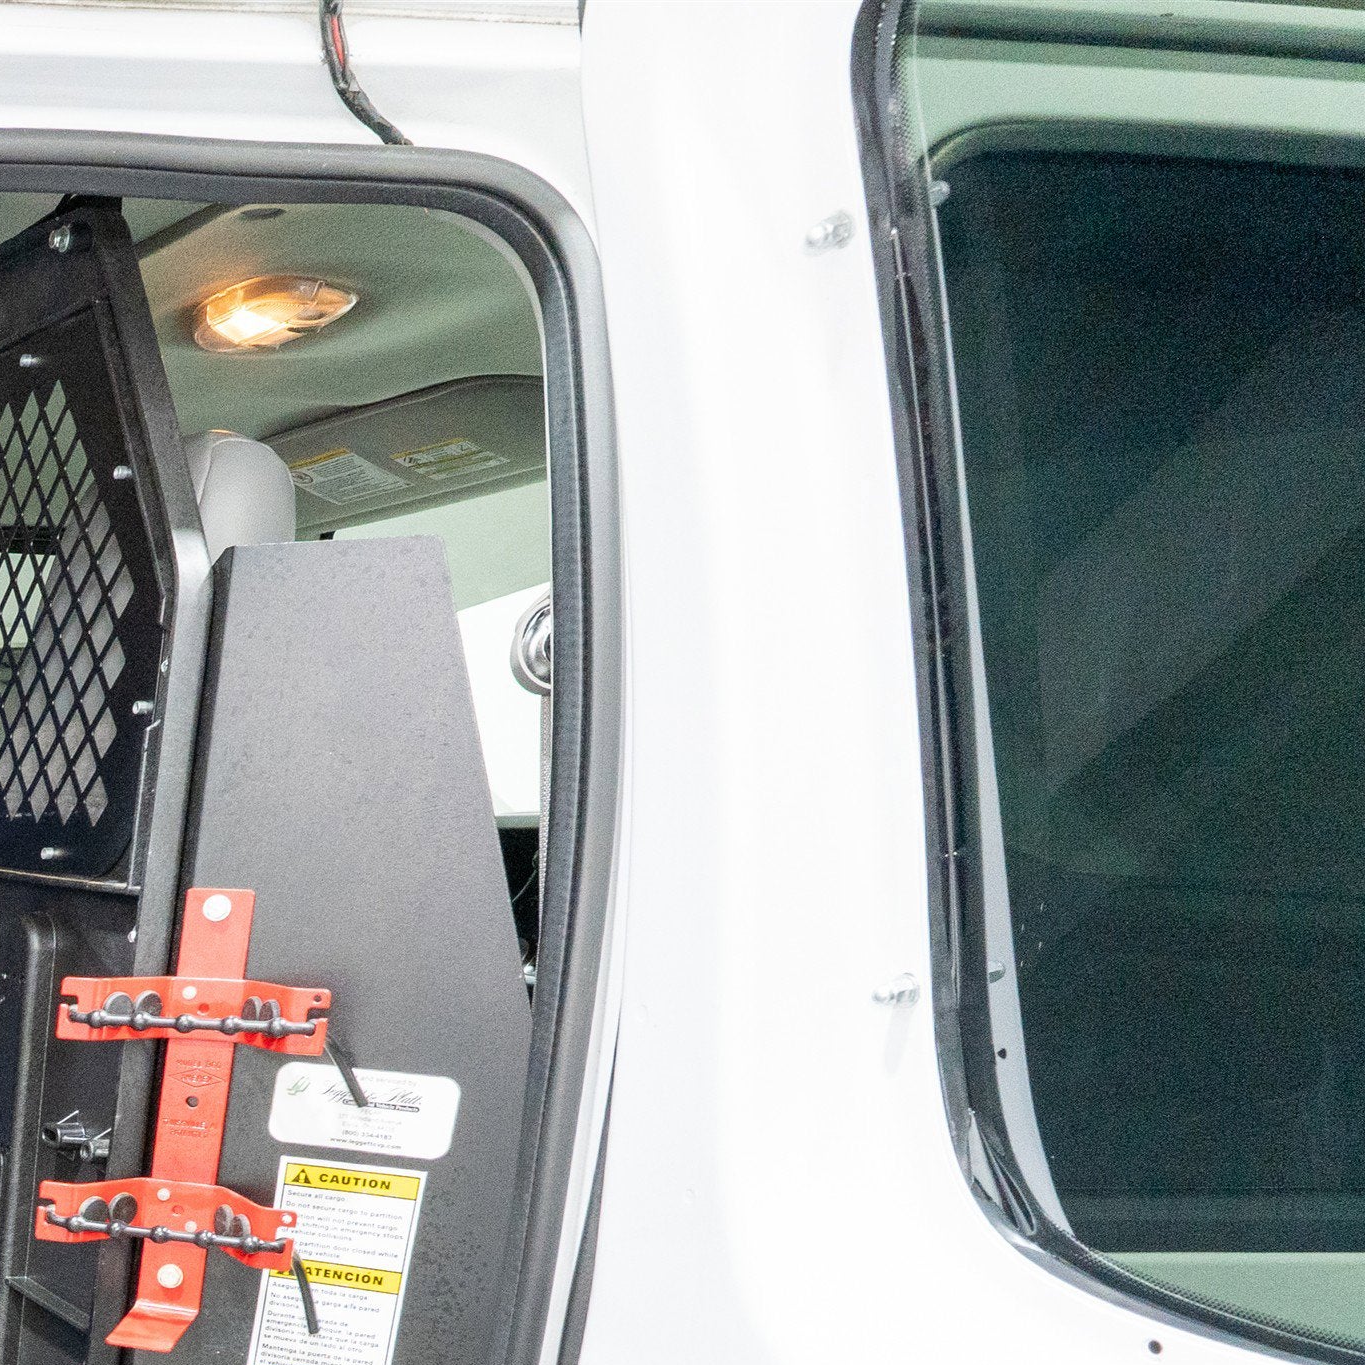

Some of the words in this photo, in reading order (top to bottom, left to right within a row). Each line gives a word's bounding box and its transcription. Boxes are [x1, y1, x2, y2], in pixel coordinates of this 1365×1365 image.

[319, 1174, 390, 1190] CAUTION
[370, 1212, 402, 1220] partition
[302, 1222, 329, 1231] shifting
[340, 1227, 380, 1237] emergency
[347, 1220, 375, 1228] prevent
[291, 1228, 315, 1236] vehicle
[299, 1241, 331, 1249] partition
[352, 1248, 375, 1256] closed
[268, 1310, 295, 1319] Durante
[262, 1343, 297, 1354] Mantenga
[307, 1351, 331, 1359] puerta
[352, 1358, 373, 1365] pared
